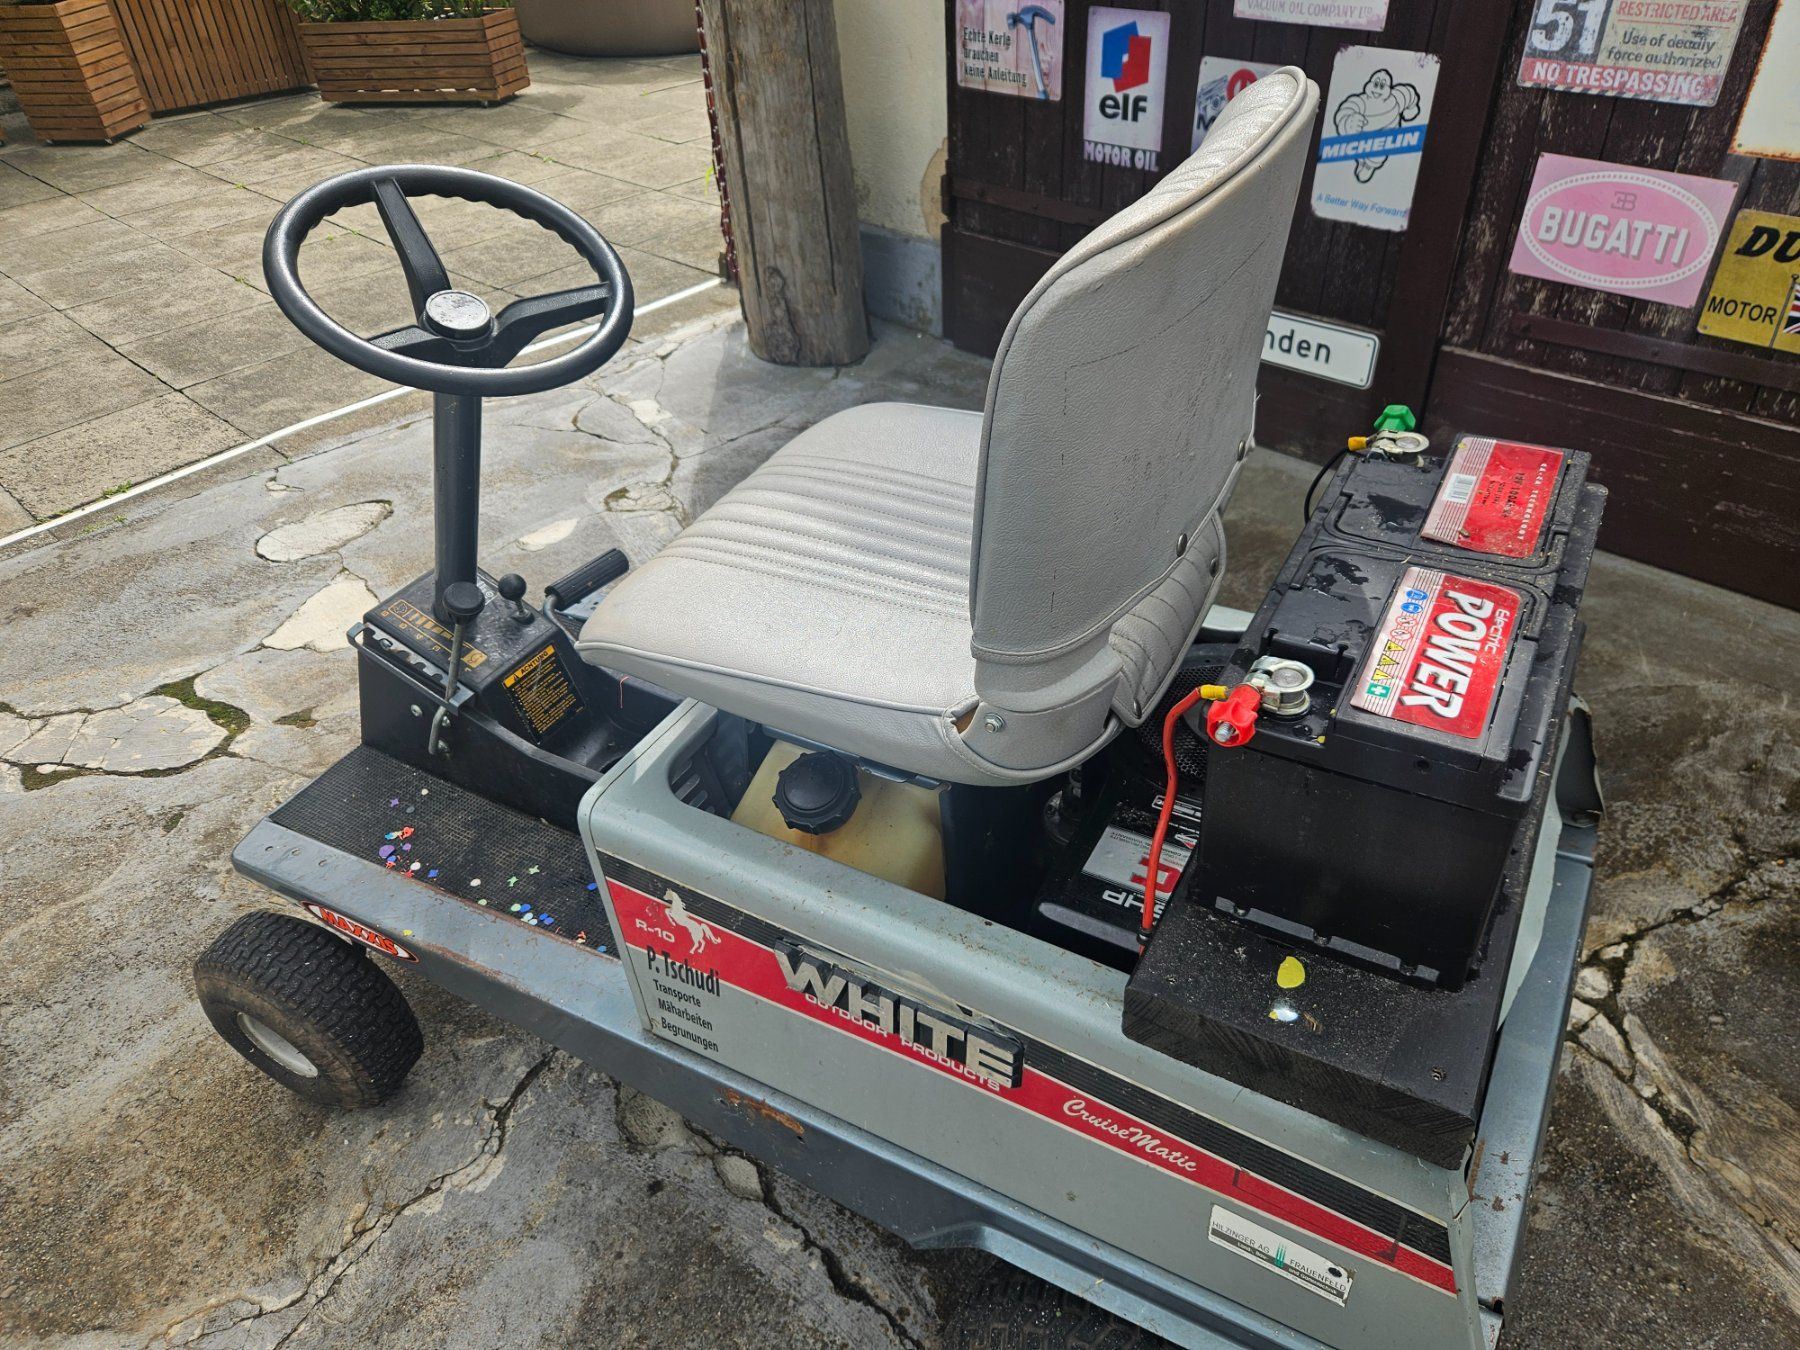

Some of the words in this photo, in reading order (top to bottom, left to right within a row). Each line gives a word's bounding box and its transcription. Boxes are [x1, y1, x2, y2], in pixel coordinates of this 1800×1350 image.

[1289, 1, 1305, 15] OIL
[1308, 3, 1356, 18] COMPANY
[1616, 0, 1698, 20] RESTRICTED
[1699, 5, 1738, 23] AREA
[963, 27, 986, 43] Echte
[988, 31, 1011, 47] Kerle
[1531, 0, 1607, 55] 51
[1623, 29, 1647, 46] Use
[1650, 34, 1666, 48] of
[1666, 34, 1717, 52] deadly
[963, 48, 999, 62] brauchen
[1607, 47, 1643, 63] force
[1645, 51, 1722, 69] authorized
[964, 62, 985, 78] keine
[987, 66, 1027, 87] Anleitung
[1533, 62, 1560, 81] NO
[1566, 65, 1706, 96] TRESPASSING
[1098, 92, 1149, 122] elf
[1083, 140, 1132, 169] MOTOR
[1134, 150, 1158, 172] OIL
[1321, 131, 1421, 159] MICHELIN
[1316, 193, 1323, 202] A
[1324, 194, 1348, 207] Better
[1350, 199, 1369, 212] Way
[1370, 202, 1409, 218] Forward
[1538, 206, 1690, 265] BUGATTI
[1707, 296, 1778, 325] MOTOR
[1517, 489, 1539, 540] TECHNOLOGY
[1483, 608, 1511, 655] Electric
[520, 649, 549, 676] ACHTUNG
[1401, 591, 1495, 719] POWER
[320, 907, 399, 957] MAXXIS
[635, 918, 675, 943] R-10
[646, 945, 660, 974] P.
[661, 950, 721, 997] Tschudi
[653, 978, 702, 1008] Transporte
[658, 998, 714, 1031] Mäharbeiten
[773, 940, 1023, 1089] WHITE
[661, 1016, 719, 1053] Begrunungen
[804, 991, 889, 1038] OUTDOOR
[901, 1036, 1001, 1092] PRODUCTS
[1062, 1098, 1198, 1173] CruiseMatic
[1212, 1220, 1256, 1247] HILZINGER
[1258, 1243, 1270, 1254] AG
[1289, 1258, 1347, 1292] FRAUENFELD
